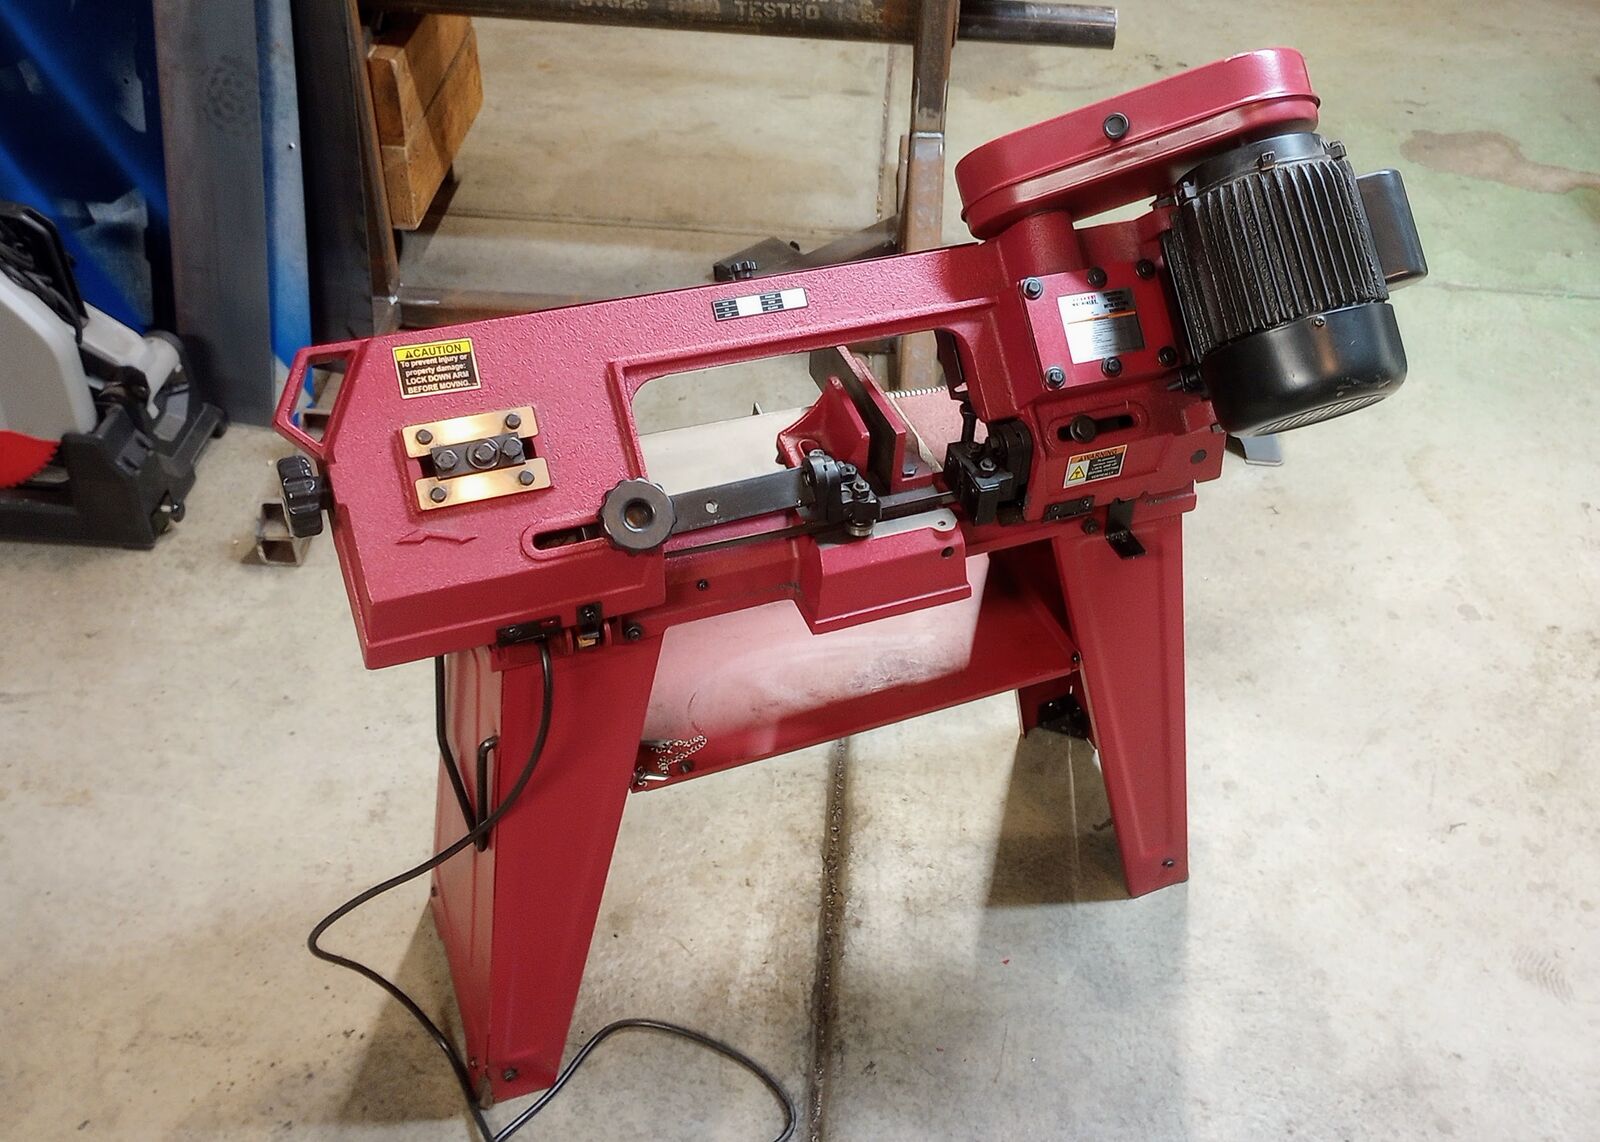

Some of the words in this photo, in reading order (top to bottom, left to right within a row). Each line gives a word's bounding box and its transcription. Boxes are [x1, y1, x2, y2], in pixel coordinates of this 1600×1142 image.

[413, 343, 462, 358] CAUTION
[400, 360, 410, 368] To
[411, 357, 438, 368] prevent
[405, 367, 435, 378] property
[436, 363, 466, 372] damage:
[406, 375, 428, 386] LOCK
[428, 373, 452, 383] DOWN
[452, 370, 470, 380] ARM
[407, 383, 439, 394] BEFORE
[1082, 448, 1118, 460] WARNING
